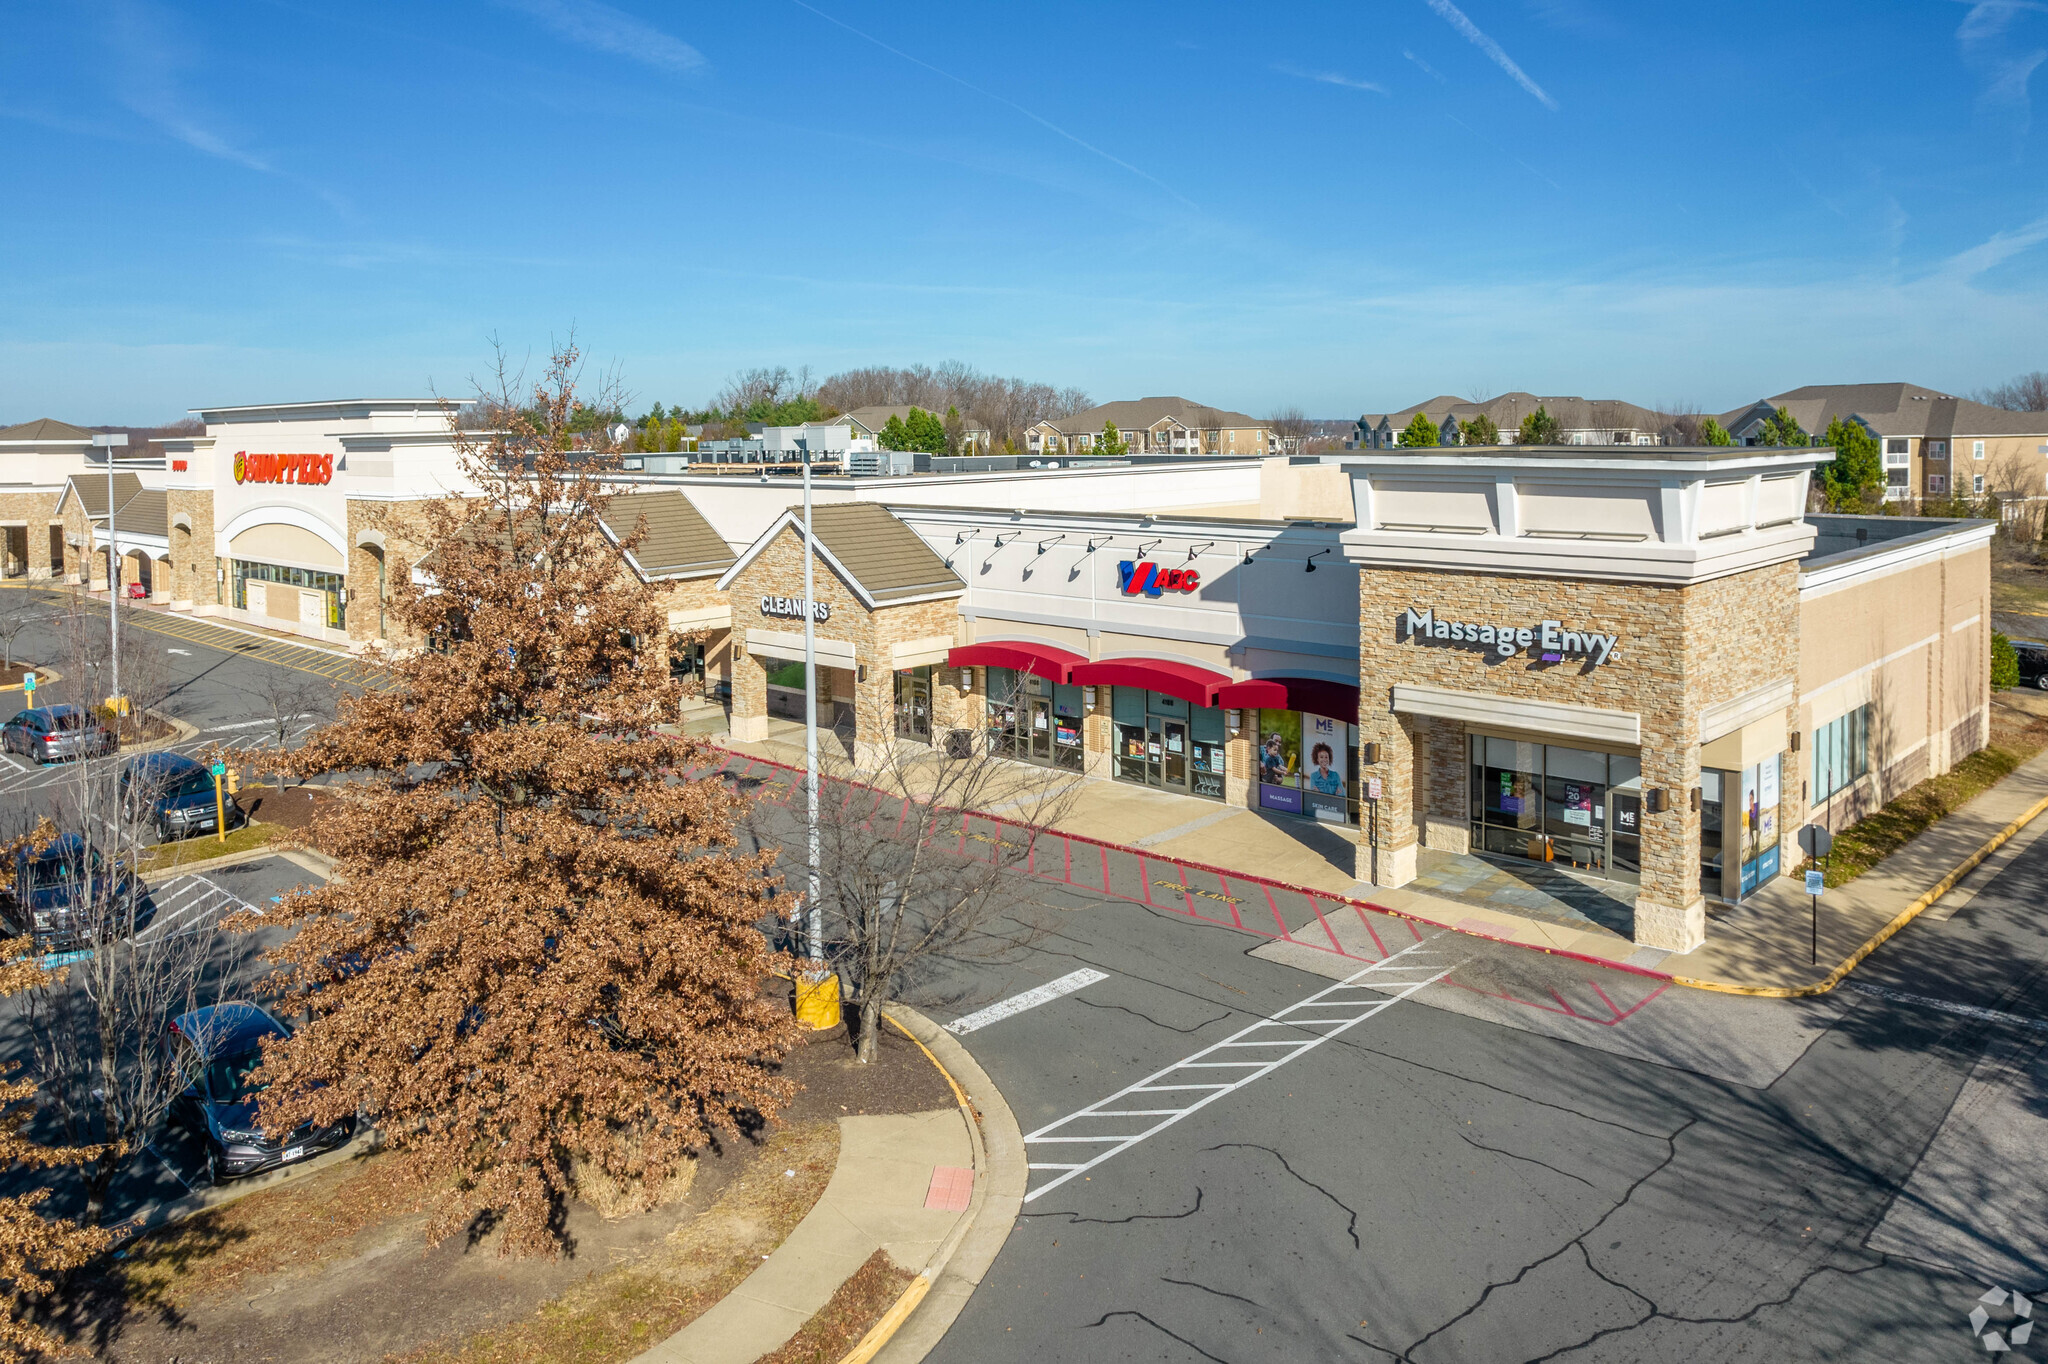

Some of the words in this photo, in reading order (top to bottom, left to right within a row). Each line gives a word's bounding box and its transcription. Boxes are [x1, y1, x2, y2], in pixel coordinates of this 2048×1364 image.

[245, 453, 333, 485] SHOPPERS
[1406, 607, 1533, 656] Massage
[1316, 717, 1333, 731] ME
[1269, 793, 1293, 803] MASSAGE
[1312, 802, 1324, 810] SKIN
[1324, 805, 1338, 813] CARE
[1620, 810, 1635, 823] ME
[1153, 880, 1193, 892] FIRE
[1195, 890, 1243, 905] LANE
